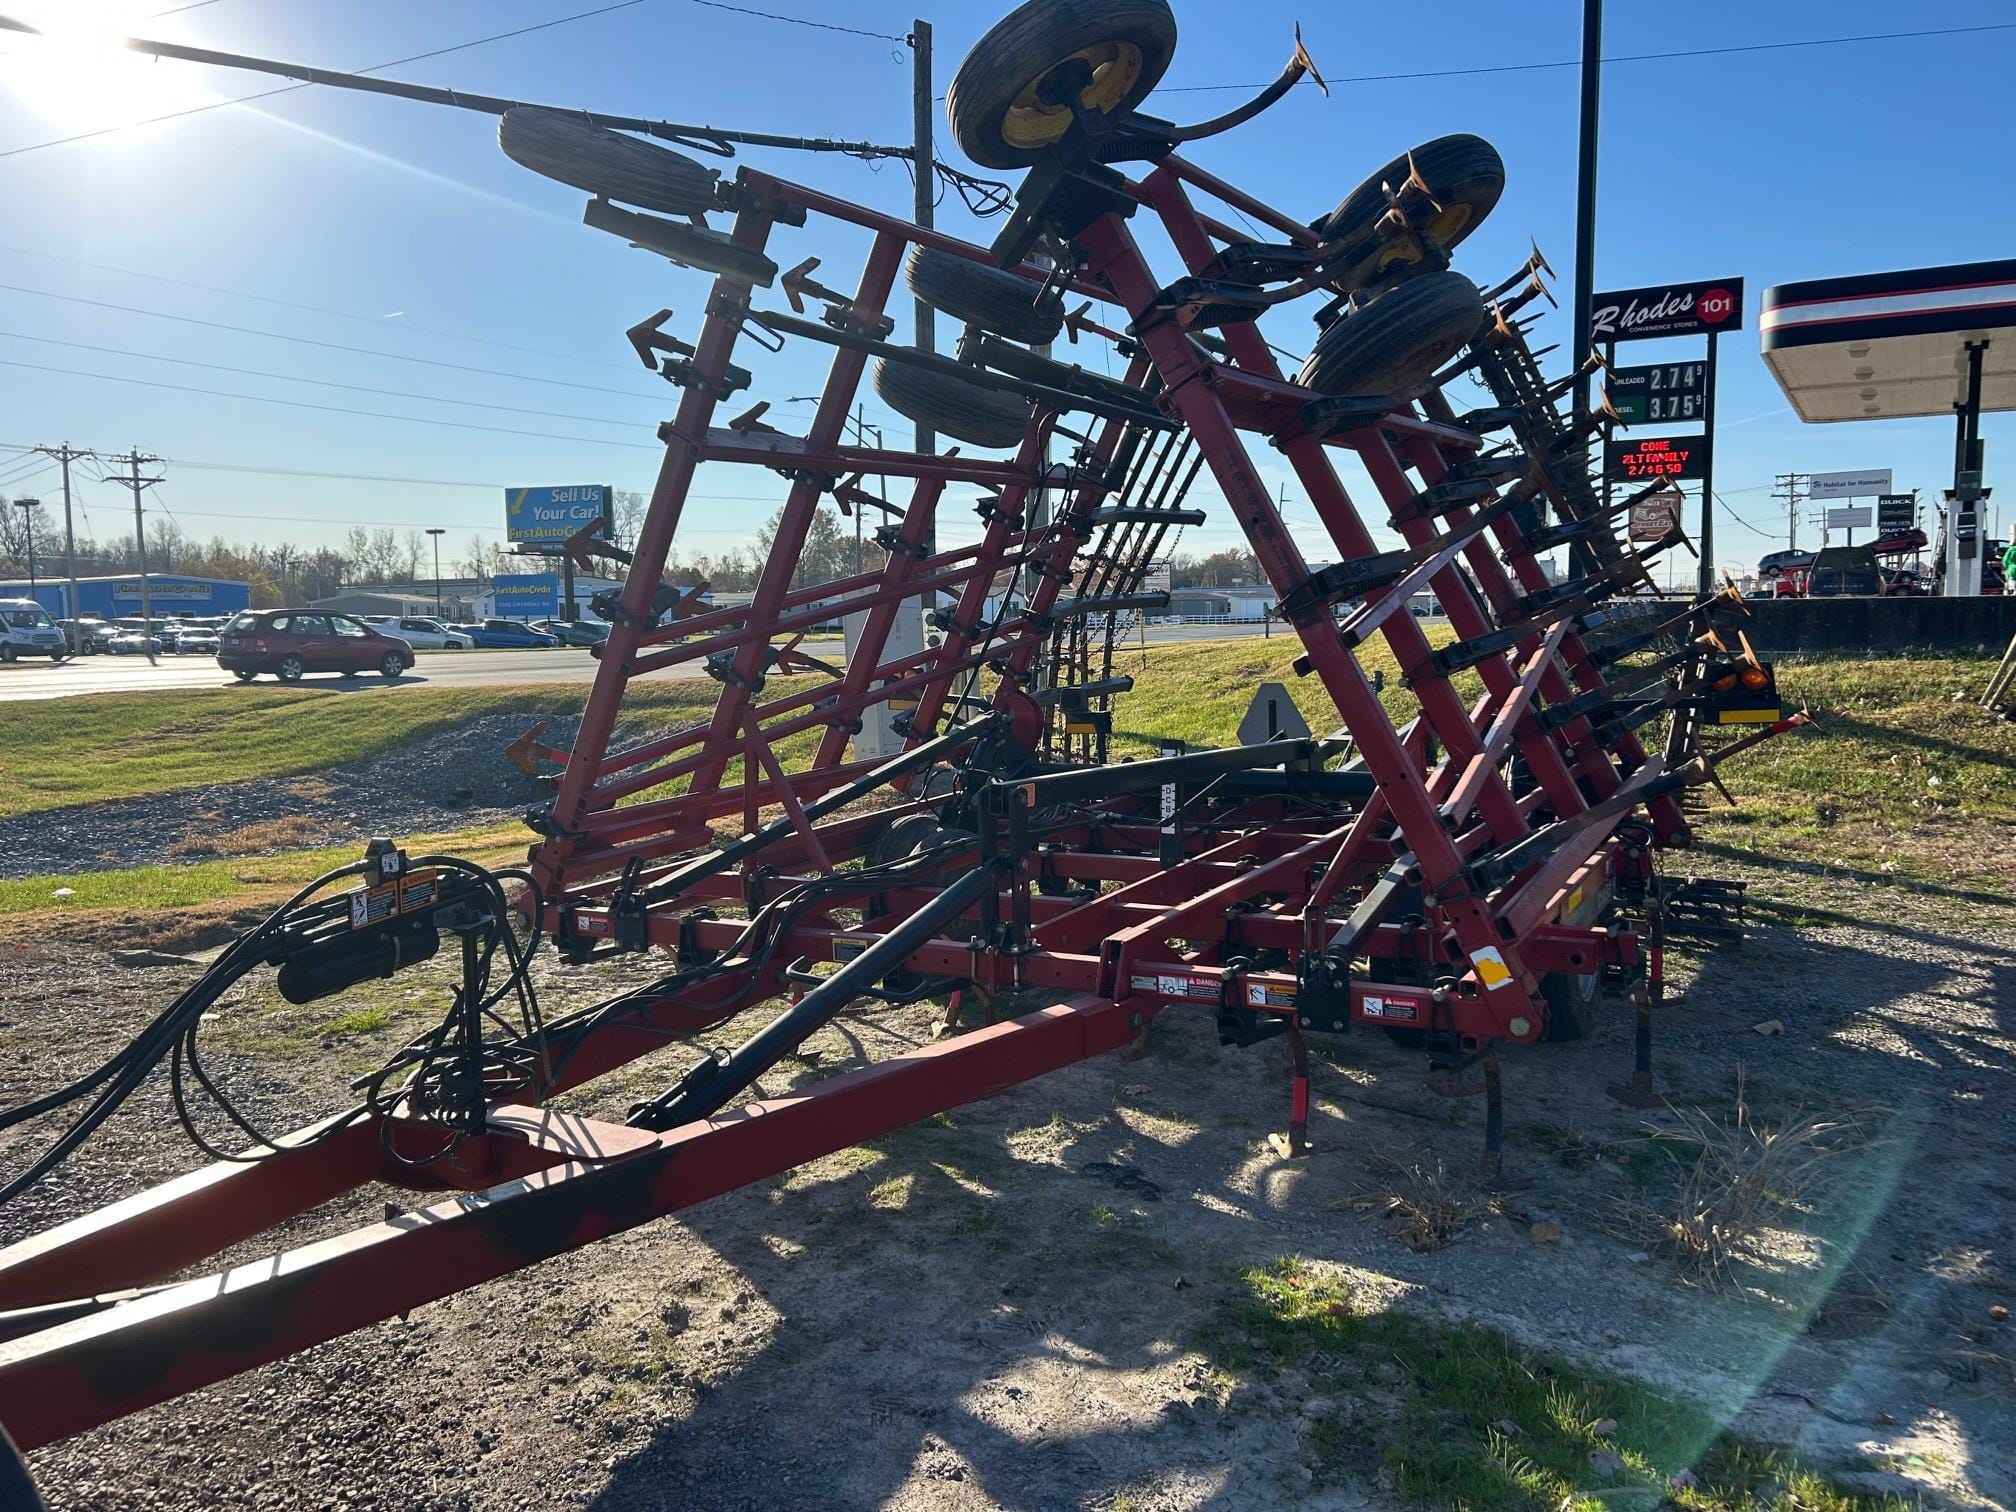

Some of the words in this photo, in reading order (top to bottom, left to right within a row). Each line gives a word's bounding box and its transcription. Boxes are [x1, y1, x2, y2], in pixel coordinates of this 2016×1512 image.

[1591, 292, 1695, 337] Rhodes
[1702, 298, 1730, 313] 101
[1629, 323, 1671, 333] CONVENIENCE
[1673, 321, 1698, 329] STORES
[1615, 376, 1645, 386] UNLEADED
[1628, 463, 1682, 475] 2/$650
[1823, 480, 1846, 488] Habitat
[1858, 478, 1888, 486] Humanity
[551, 488, 576, 502] Sell
[581, 488, 599, 501] Us
[533, 507, 566, 520] Your
[570, 505, 600, 519] Car!
[496, 585, 551, 595] FirstAutoCredit
